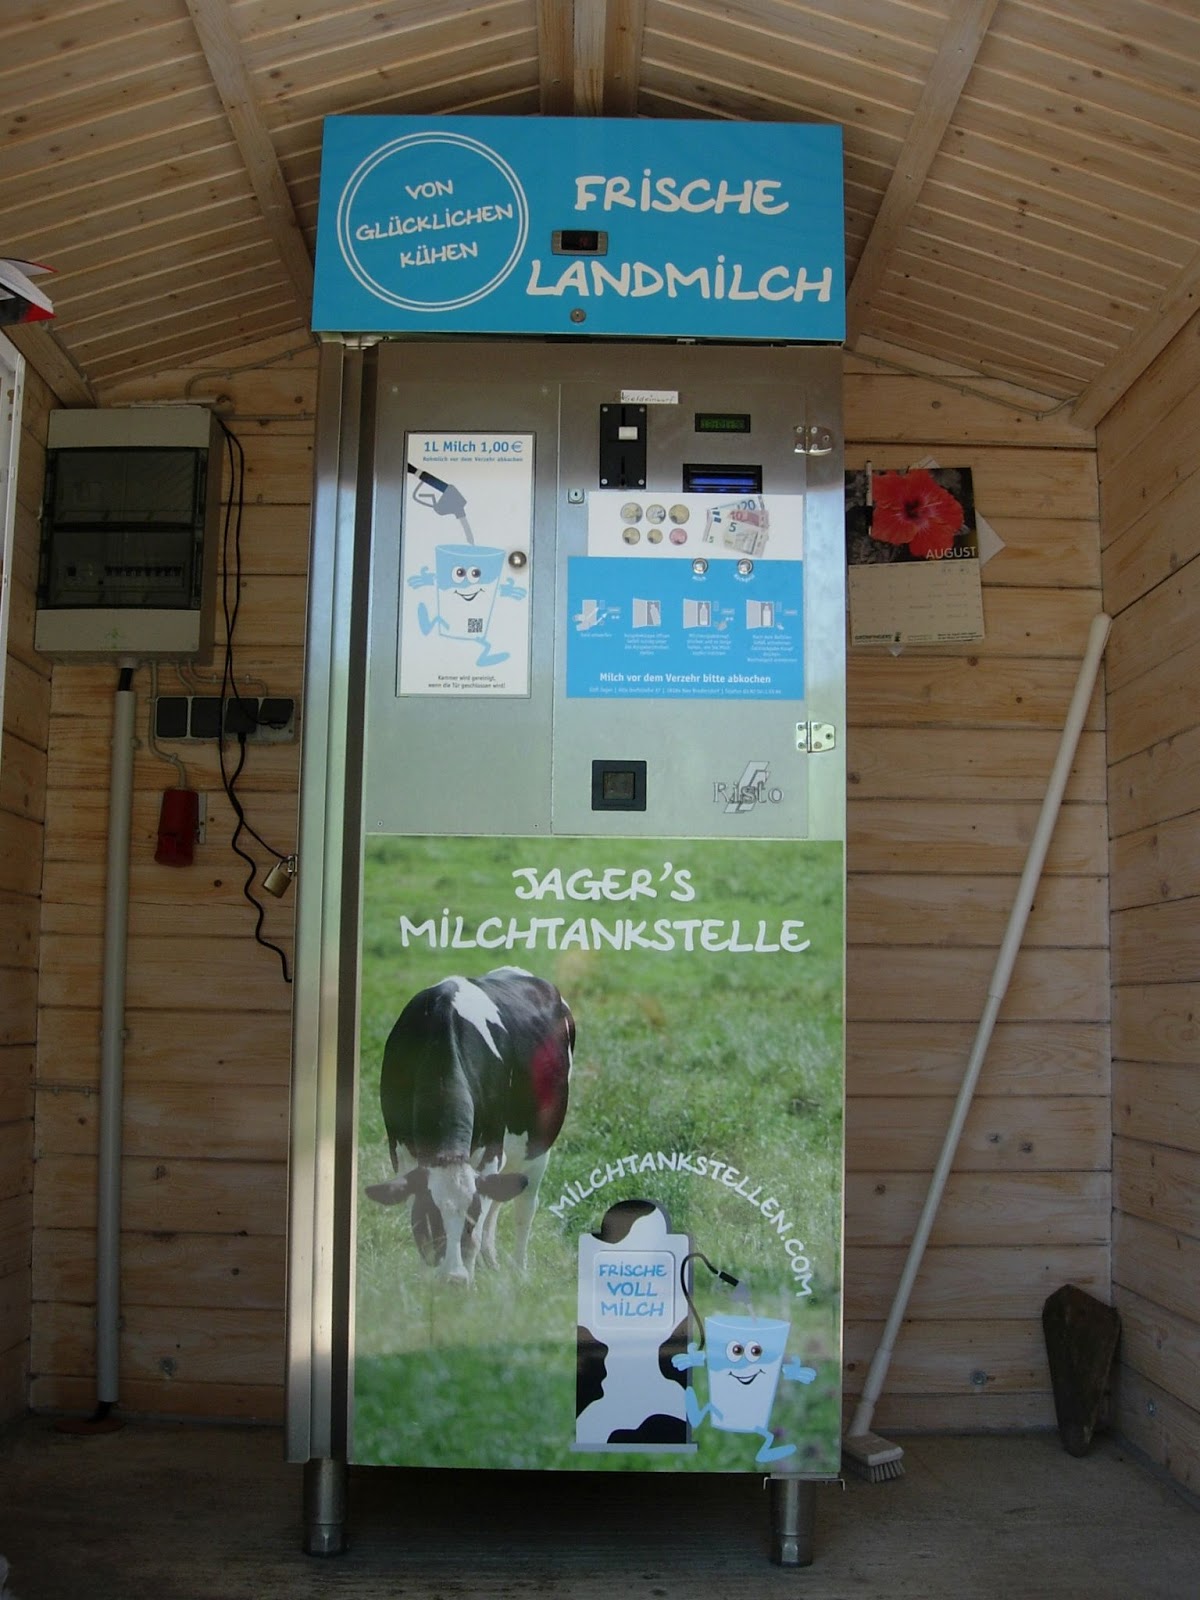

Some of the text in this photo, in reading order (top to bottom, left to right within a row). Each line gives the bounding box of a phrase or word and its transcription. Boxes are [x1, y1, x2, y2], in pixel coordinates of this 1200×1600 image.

[404, 178, 454, 200] VON
[399, 241, 479, 269] KÜHEN
[424, 441, 439, 453] 1L
[443, 440, 476, 453] Milch
[925, 546, 977, 560] AUGUST
[600, 672, 772, 684] Milch vor dem Verzehr bitte abkochen
[713, 781, 784, 804] Risto
[606, 1282, 658, 1298] VOLL
